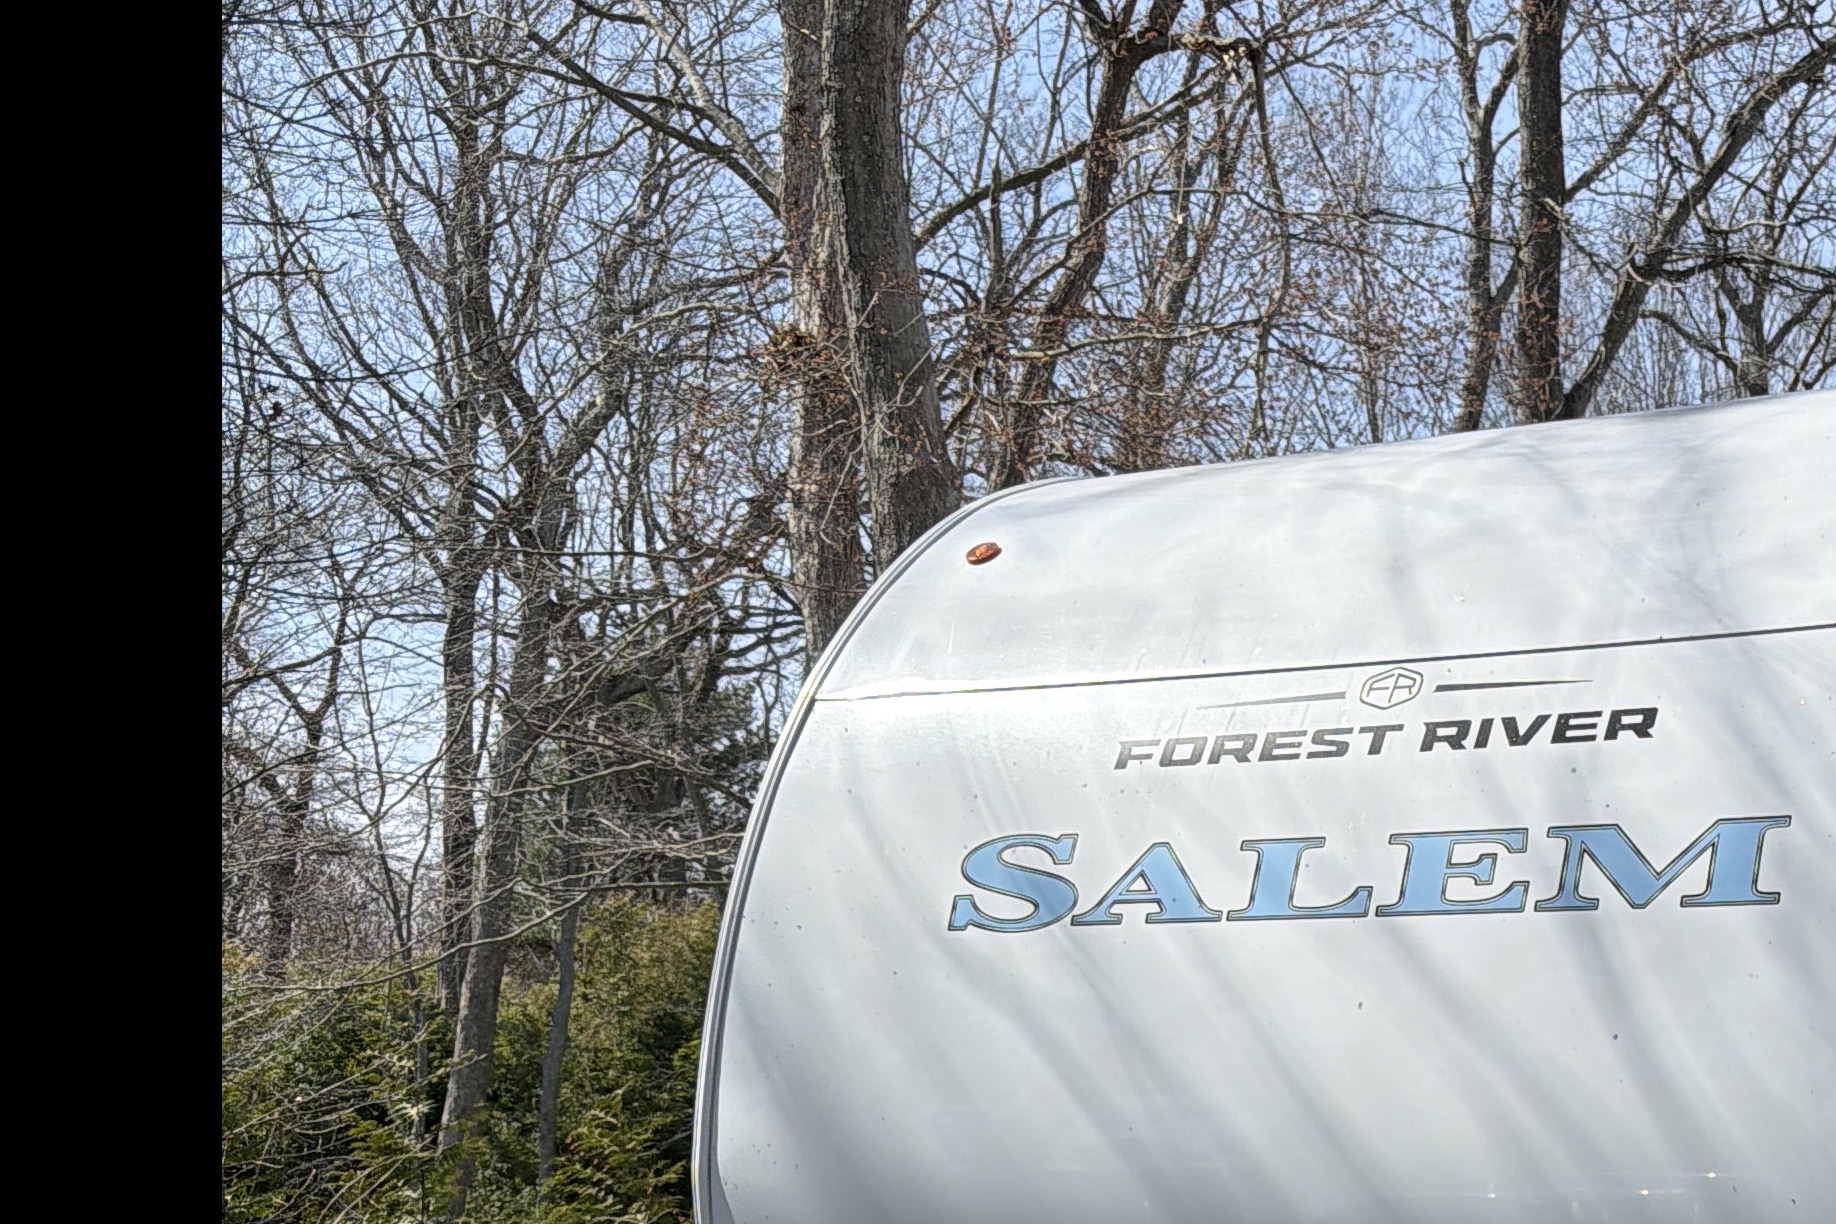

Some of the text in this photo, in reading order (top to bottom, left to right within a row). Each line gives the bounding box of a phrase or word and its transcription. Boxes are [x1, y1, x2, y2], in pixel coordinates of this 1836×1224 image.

[1114, 706, 1660, 771] FOREST RIVER
[947, 814, 1793, 933] SALEM
